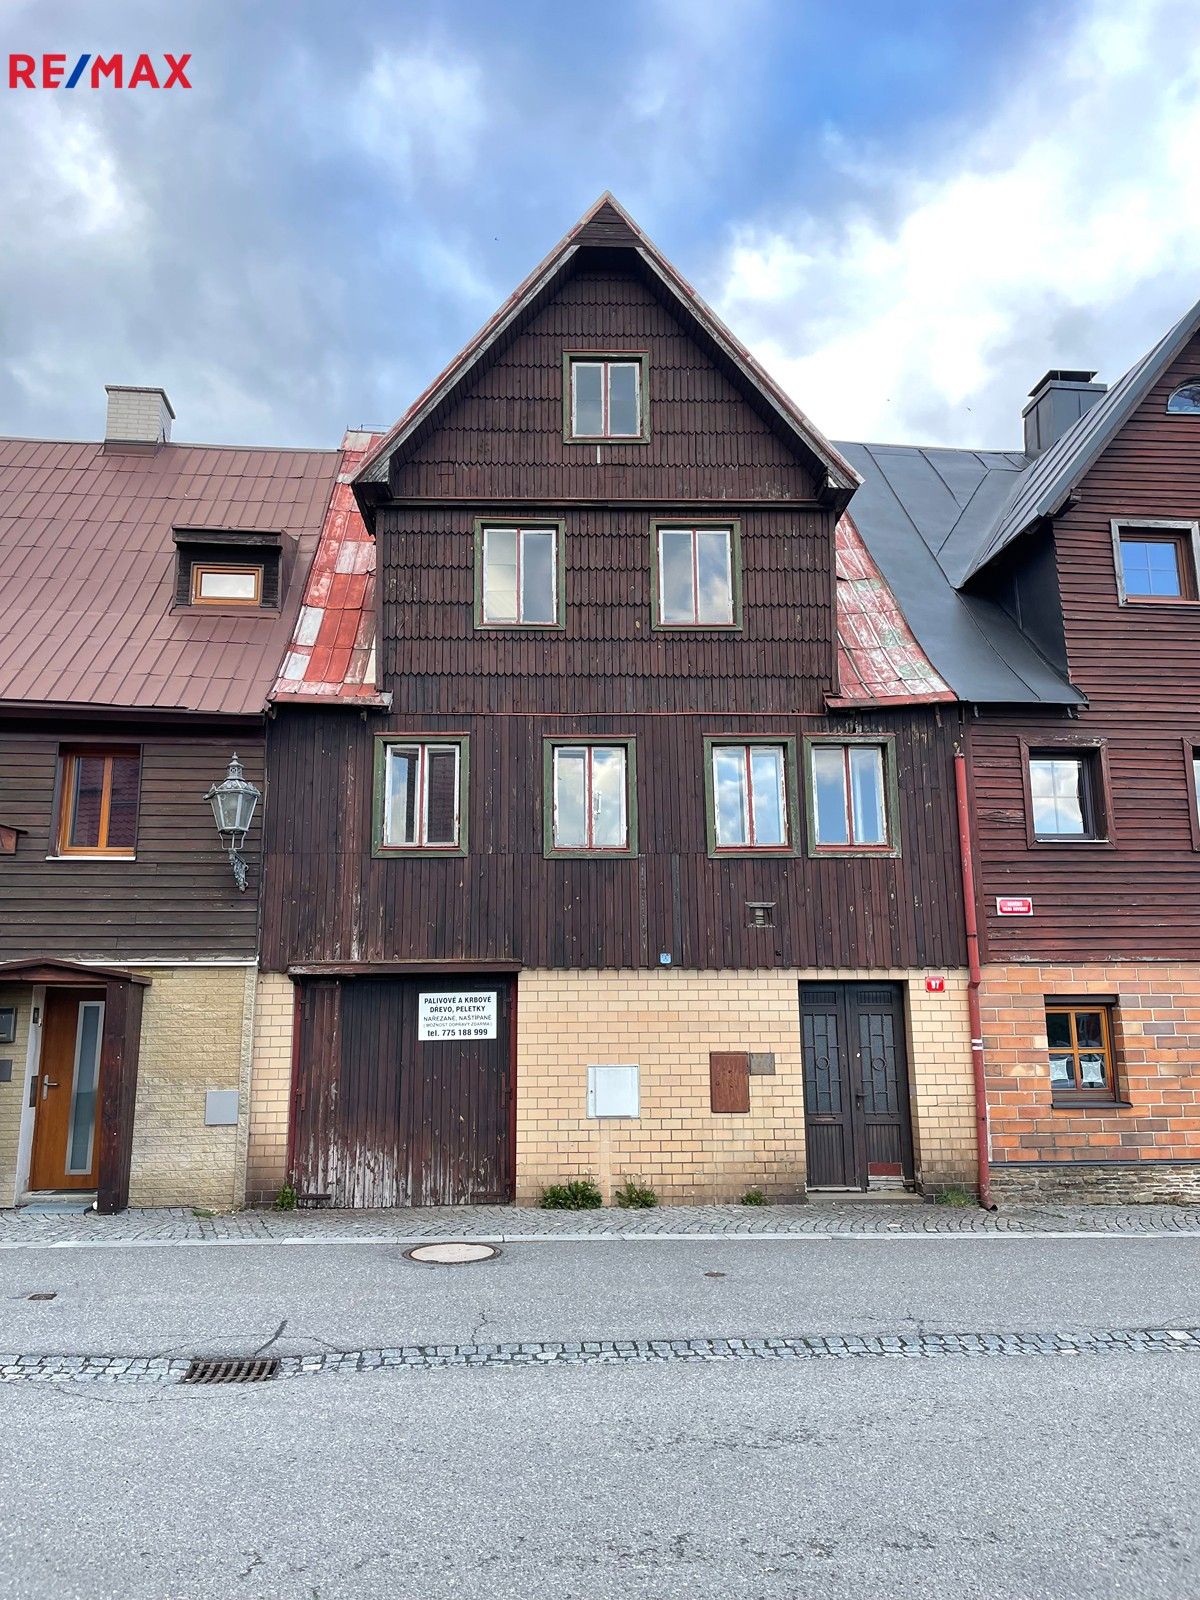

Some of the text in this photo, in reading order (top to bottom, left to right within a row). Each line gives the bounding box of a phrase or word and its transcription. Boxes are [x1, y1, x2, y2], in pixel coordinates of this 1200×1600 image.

[424, 996, 456, 1004] PALIVOVÉ
[464, 995, 492, 1003] KRBOVÉ
[429, 1005, 455, 1013] DŘEVO,
[458, 1028, 472, 1036] 188
